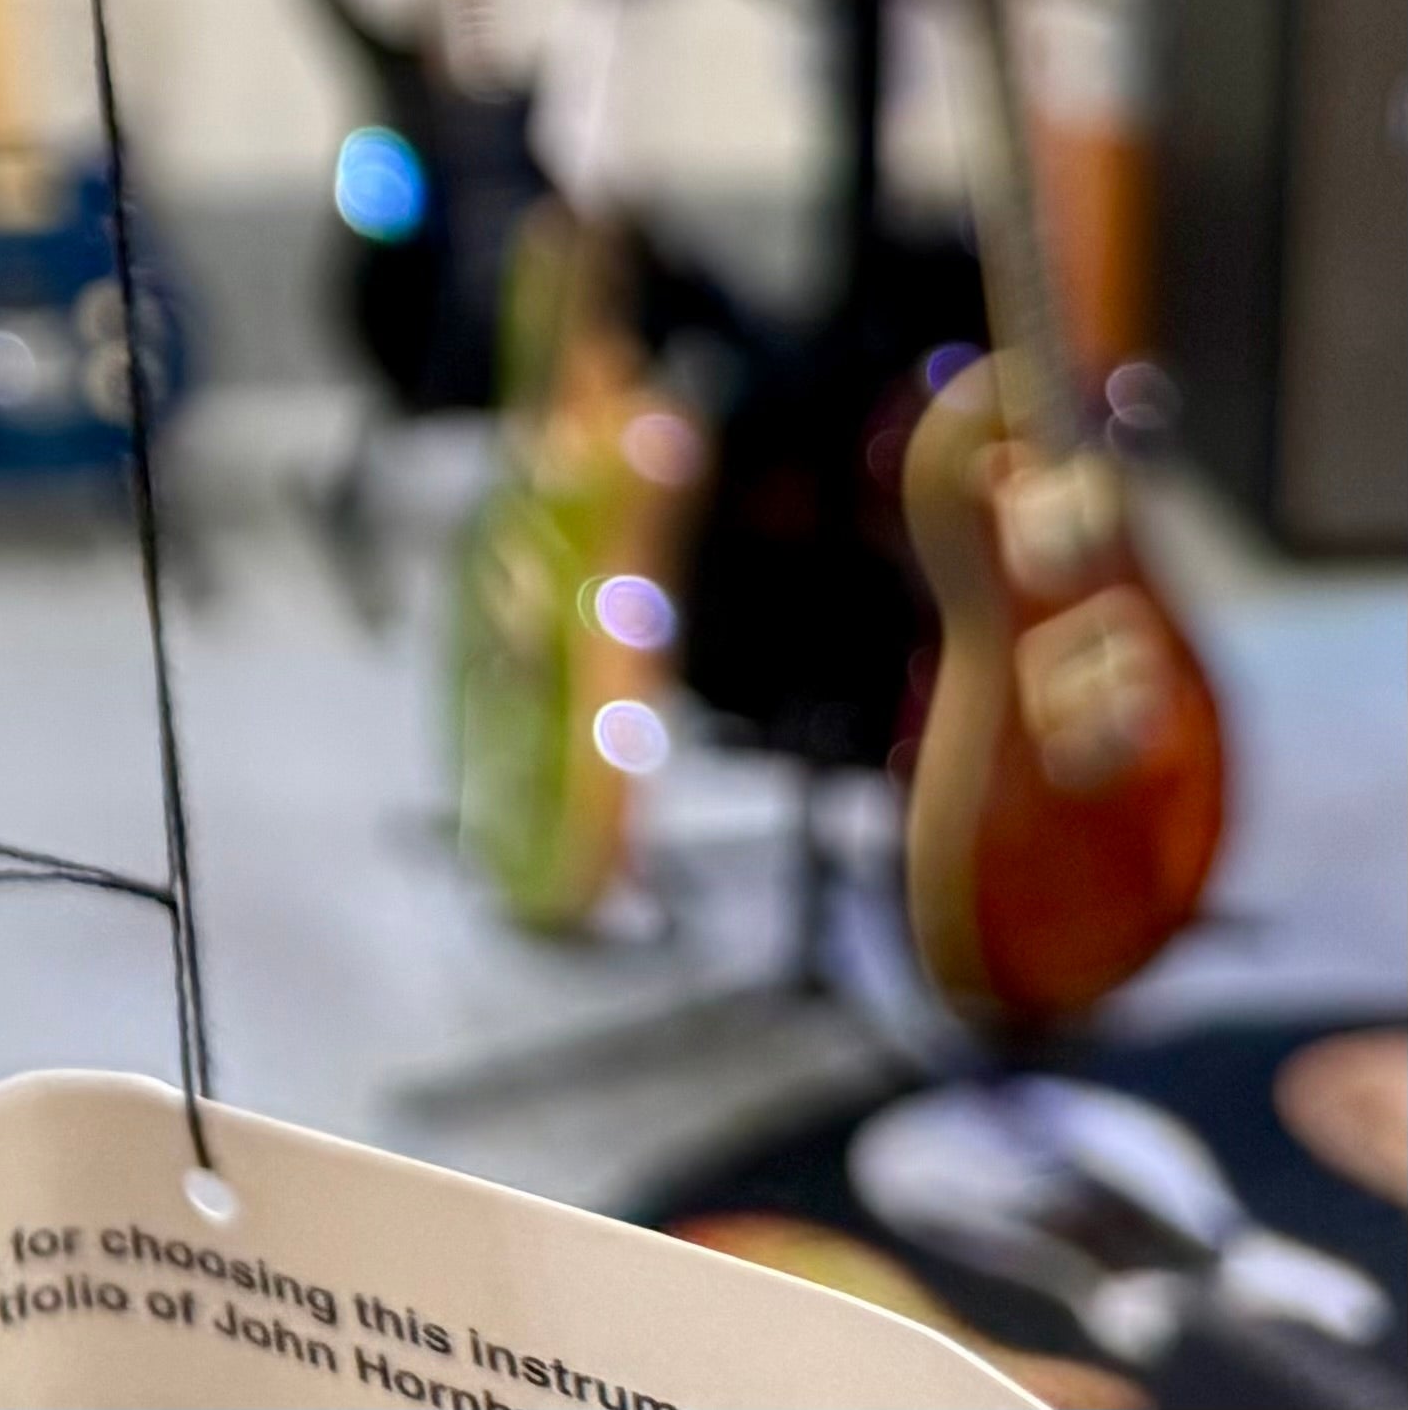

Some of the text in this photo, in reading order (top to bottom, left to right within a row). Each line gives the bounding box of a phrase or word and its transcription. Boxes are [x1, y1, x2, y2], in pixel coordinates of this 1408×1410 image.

[12, 1226, 82, 1263] for
[100, 1224, 338, 1326] choosing
[354, 1292, 452, 1355] this
[145, 1289, 196, 1325] of
[214, 1300, 338, 1373] John
